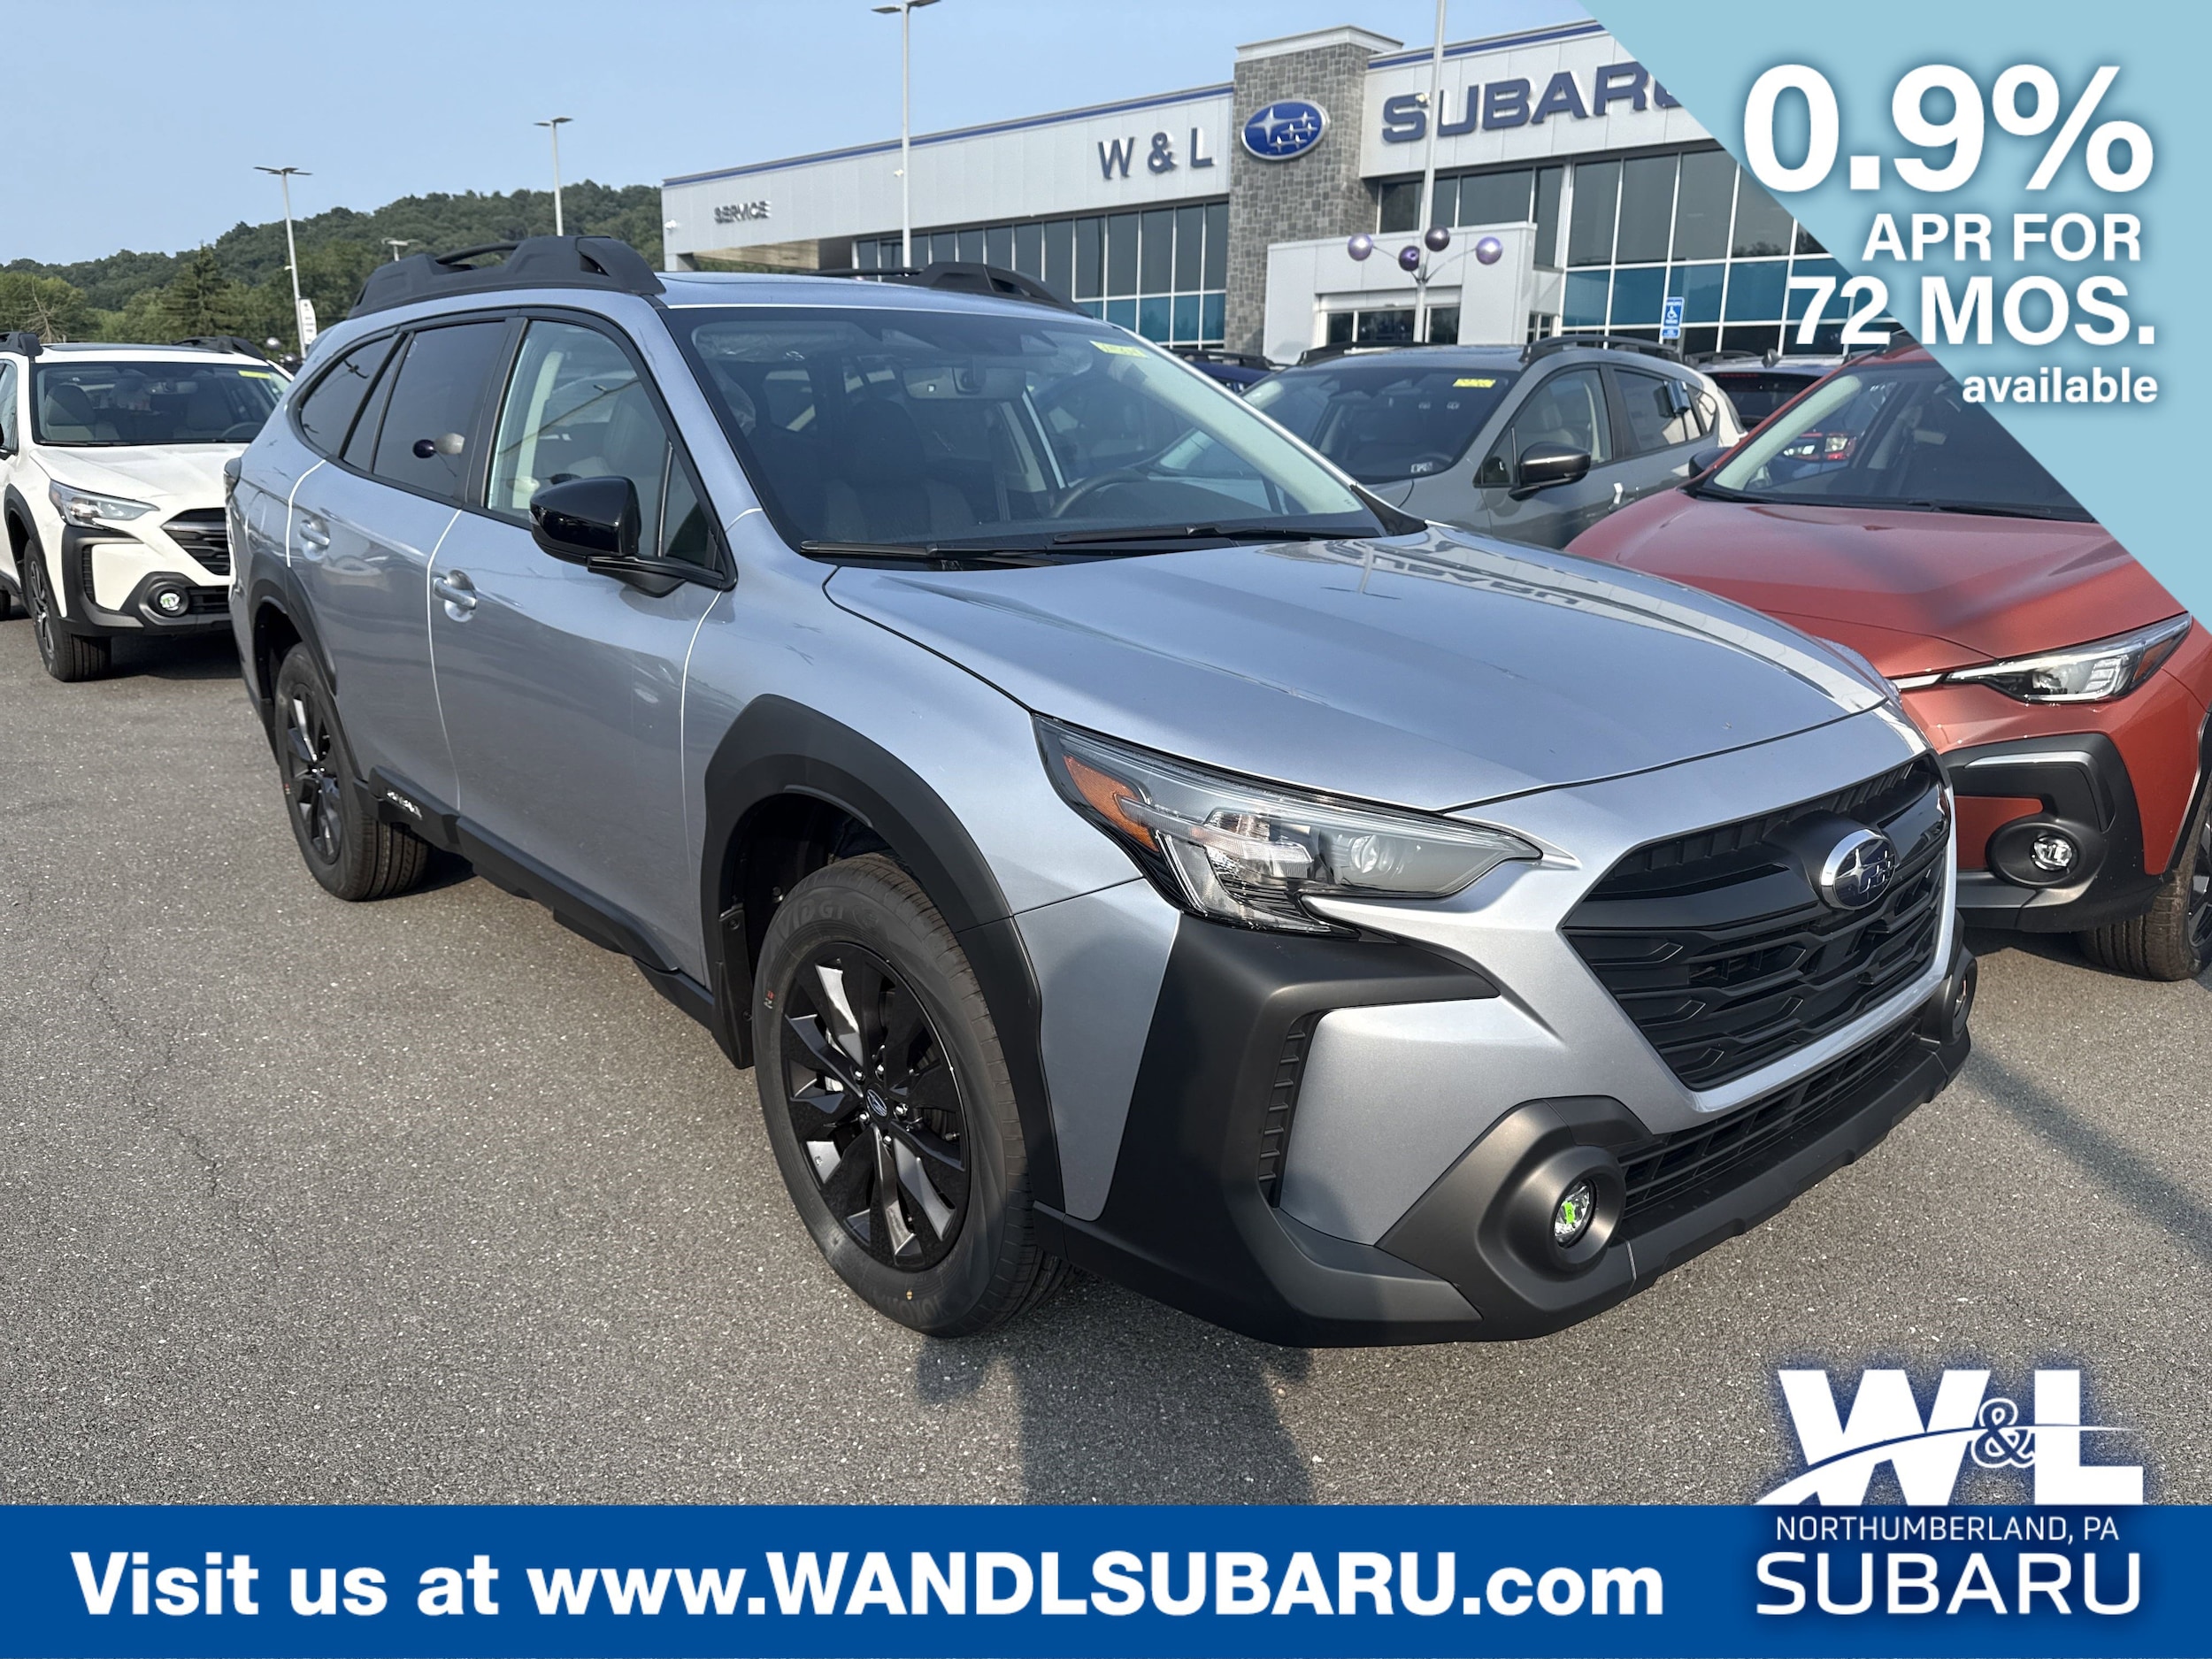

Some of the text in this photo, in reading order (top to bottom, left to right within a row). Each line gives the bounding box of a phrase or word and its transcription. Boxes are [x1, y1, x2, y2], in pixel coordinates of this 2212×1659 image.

[1097, 127, 1215, 180] W & L
[713, 200, 771, 224] SERVICE
